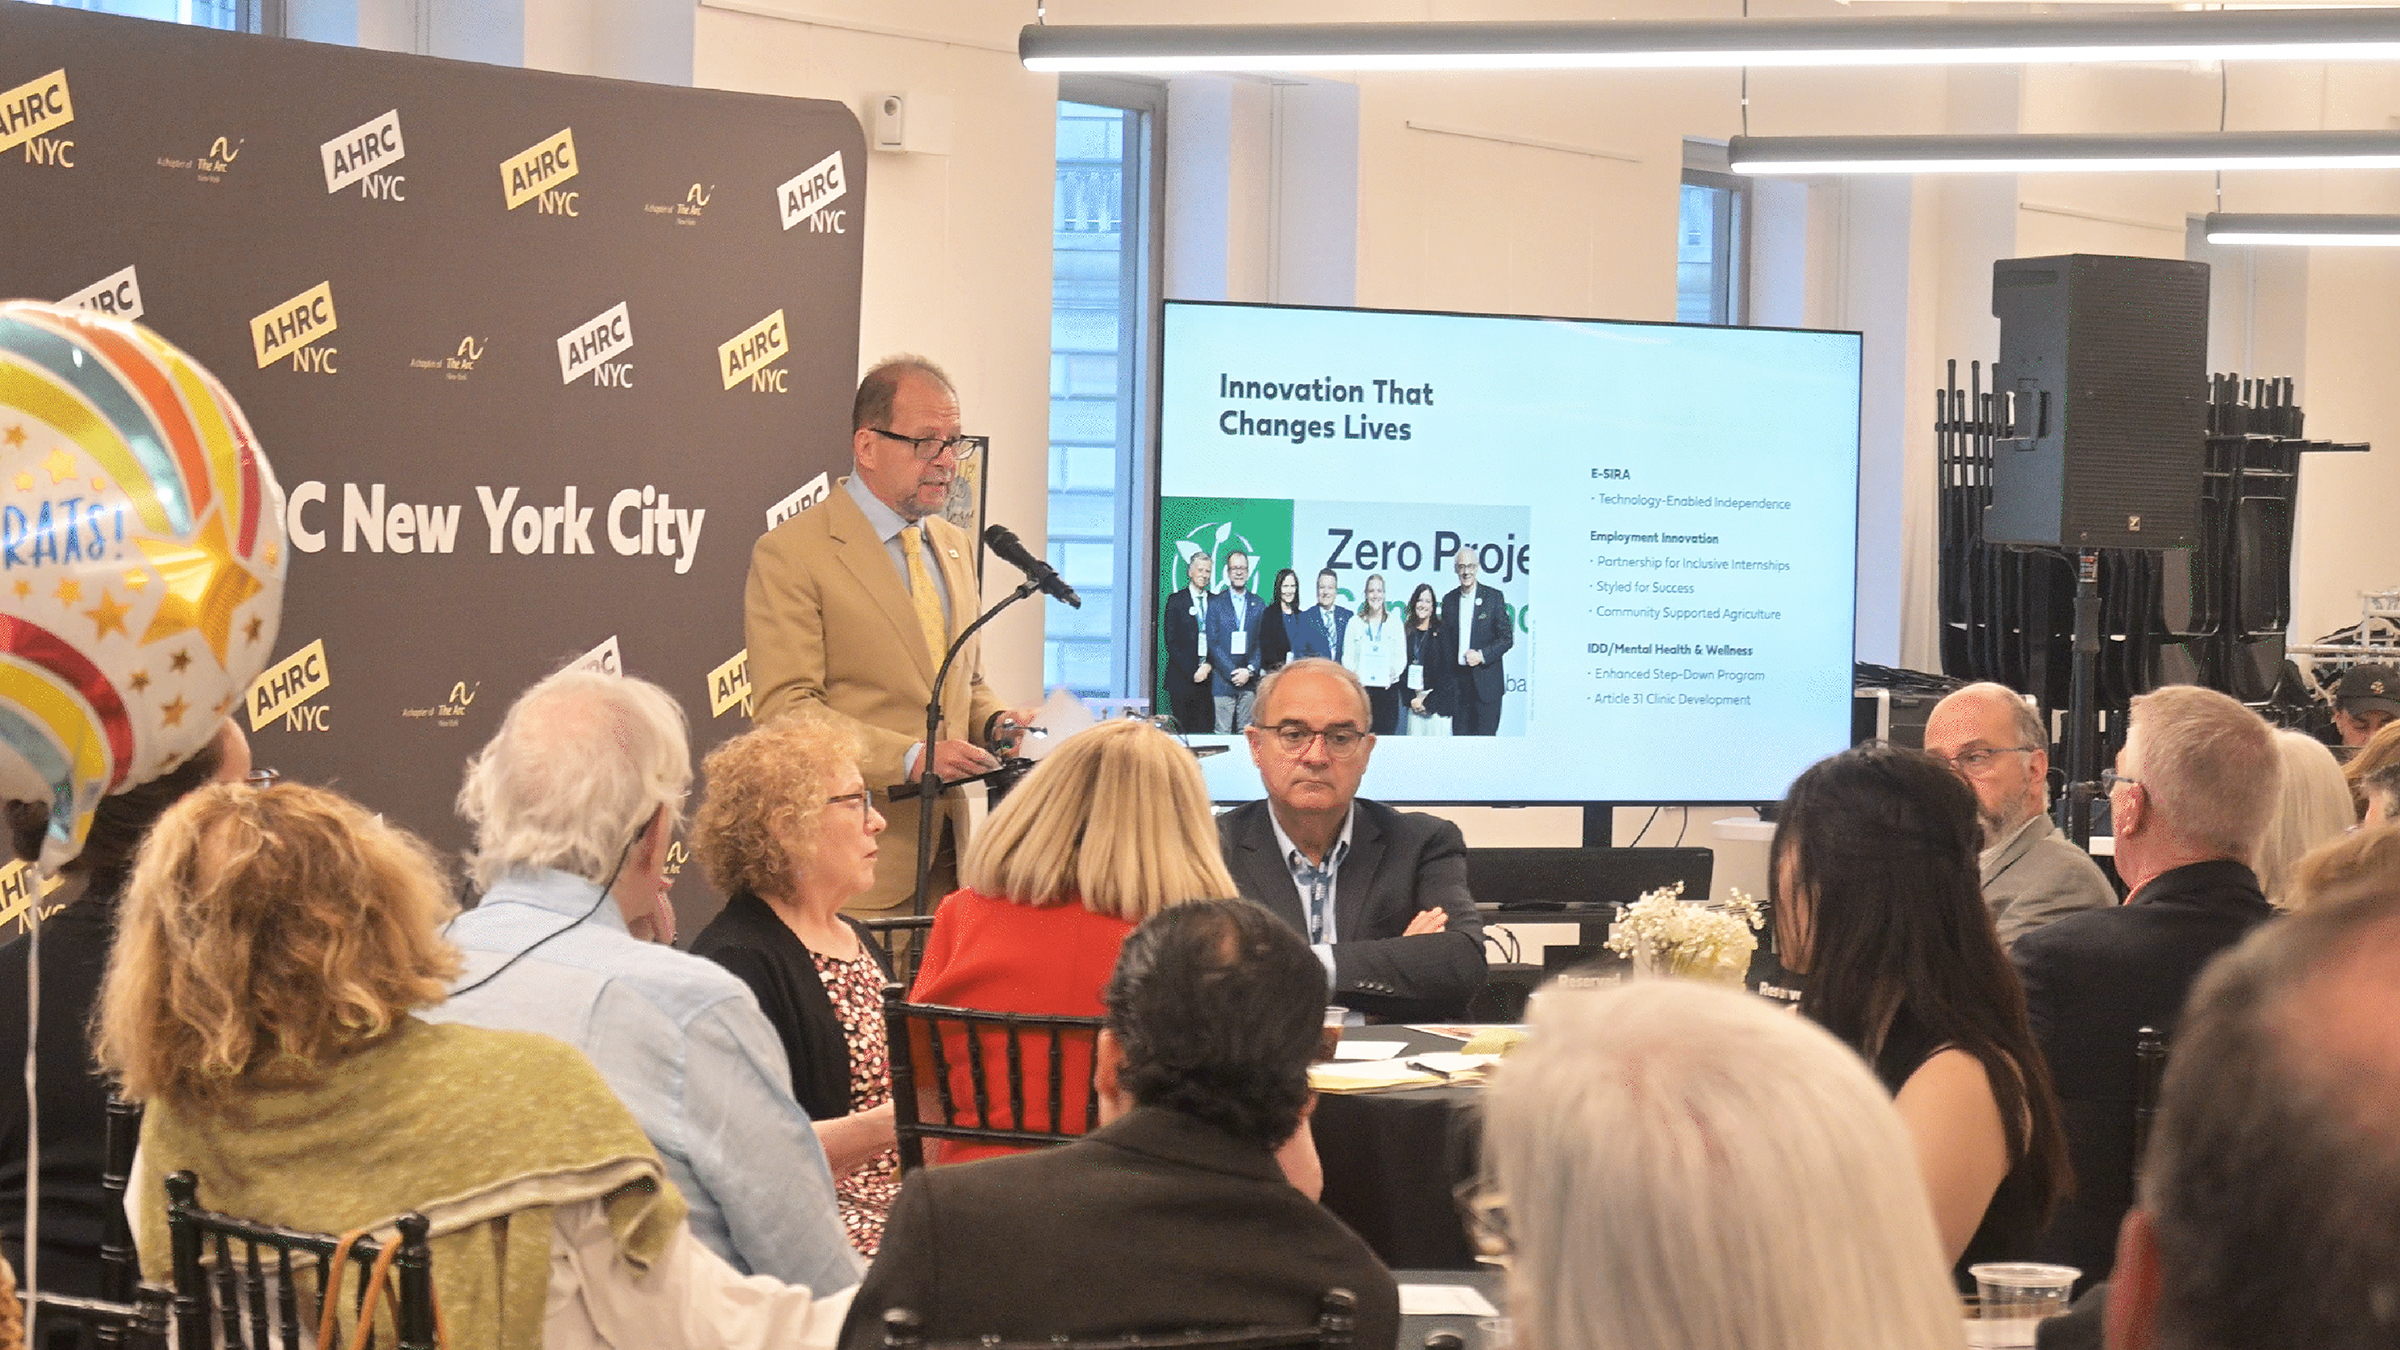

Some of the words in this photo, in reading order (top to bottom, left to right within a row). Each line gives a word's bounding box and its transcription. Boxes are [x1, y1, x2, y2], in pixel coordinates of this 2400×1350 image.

[25, 138, 75, 169] NYC
[333, 124, 396, 180] AHRC
[512, 141, 570, 197] AHRC
[362, 174, 405, 202] NYC
[787, 164, 840, 219] AHRC
[538, 191, 579, 217] NYC
[810, 210, 846, 234] NYC
[263, 295, 329, 356] AHRC
[568, 315, 626, 373] AHRC
[727, 322, 782, 379] AHRC
[293, 348, 338, 374] NYC
[593, 363, 634, 388] NYC
[752, 368, 788, 393] NYC
[1219, 373, 1364, 402] Innovation
[1372, 379, 1434, 406] That
[1219, 410, 1336, 444] Changes
[1344, 413, 1412, 441] Lives
[1591, 468, 1631, 480] E-SIRA
[1599, 493, 1712, 508] Technology-Enabled
[1714, 497, 1791, 511] Independence
[342, 483, 462, 554] New
[475, 485, 595, 555] York
[607, 484, 706, 574] City
[1590, 531, 1659, 545] Employment
[1661, 532, 1719, 545] Innovation
[1326, 528, 1422, 572] Zero
[1597, 555, 1662, 570] Partnership
[1665, 557, 1680, 568] for
[1683, 558, 1729, 570] Inclusive
[1731, 559, 1790, 573] Internships
[1596, 580, 1632, 595] Styled
[1634, 581, 1650, 593] for
[1652, 582, 1695, 594] Success
[1596, 606, 1661, 620] Community
[1663, 607, 1720, 621] Supported
[1722, 608, 1782, 622] Agriculture
[1587, 643, 1652, 656] IDD/Mental
[1655, 644, 1691, 655] Health
[1695, 644, 1703, 655] &
[1706, 644, 1753, 656] Wellness
[257, 653, 321, 717] AHRC
[717, 661, 749, 704] AH
[1595, 668, 1650, 680] Enhanced
[1653, 668, 1714, 682] Step-Down
[1717, 669, 1765, 683] Program
[1595, 693, 1630, 705] Article
[1633, 694, 1643, 705] 31
[1646, 693, 1675, 705] Clinic
[1678, 694, 1751, 708] Development
[285, 705, 330, 733] NYC
